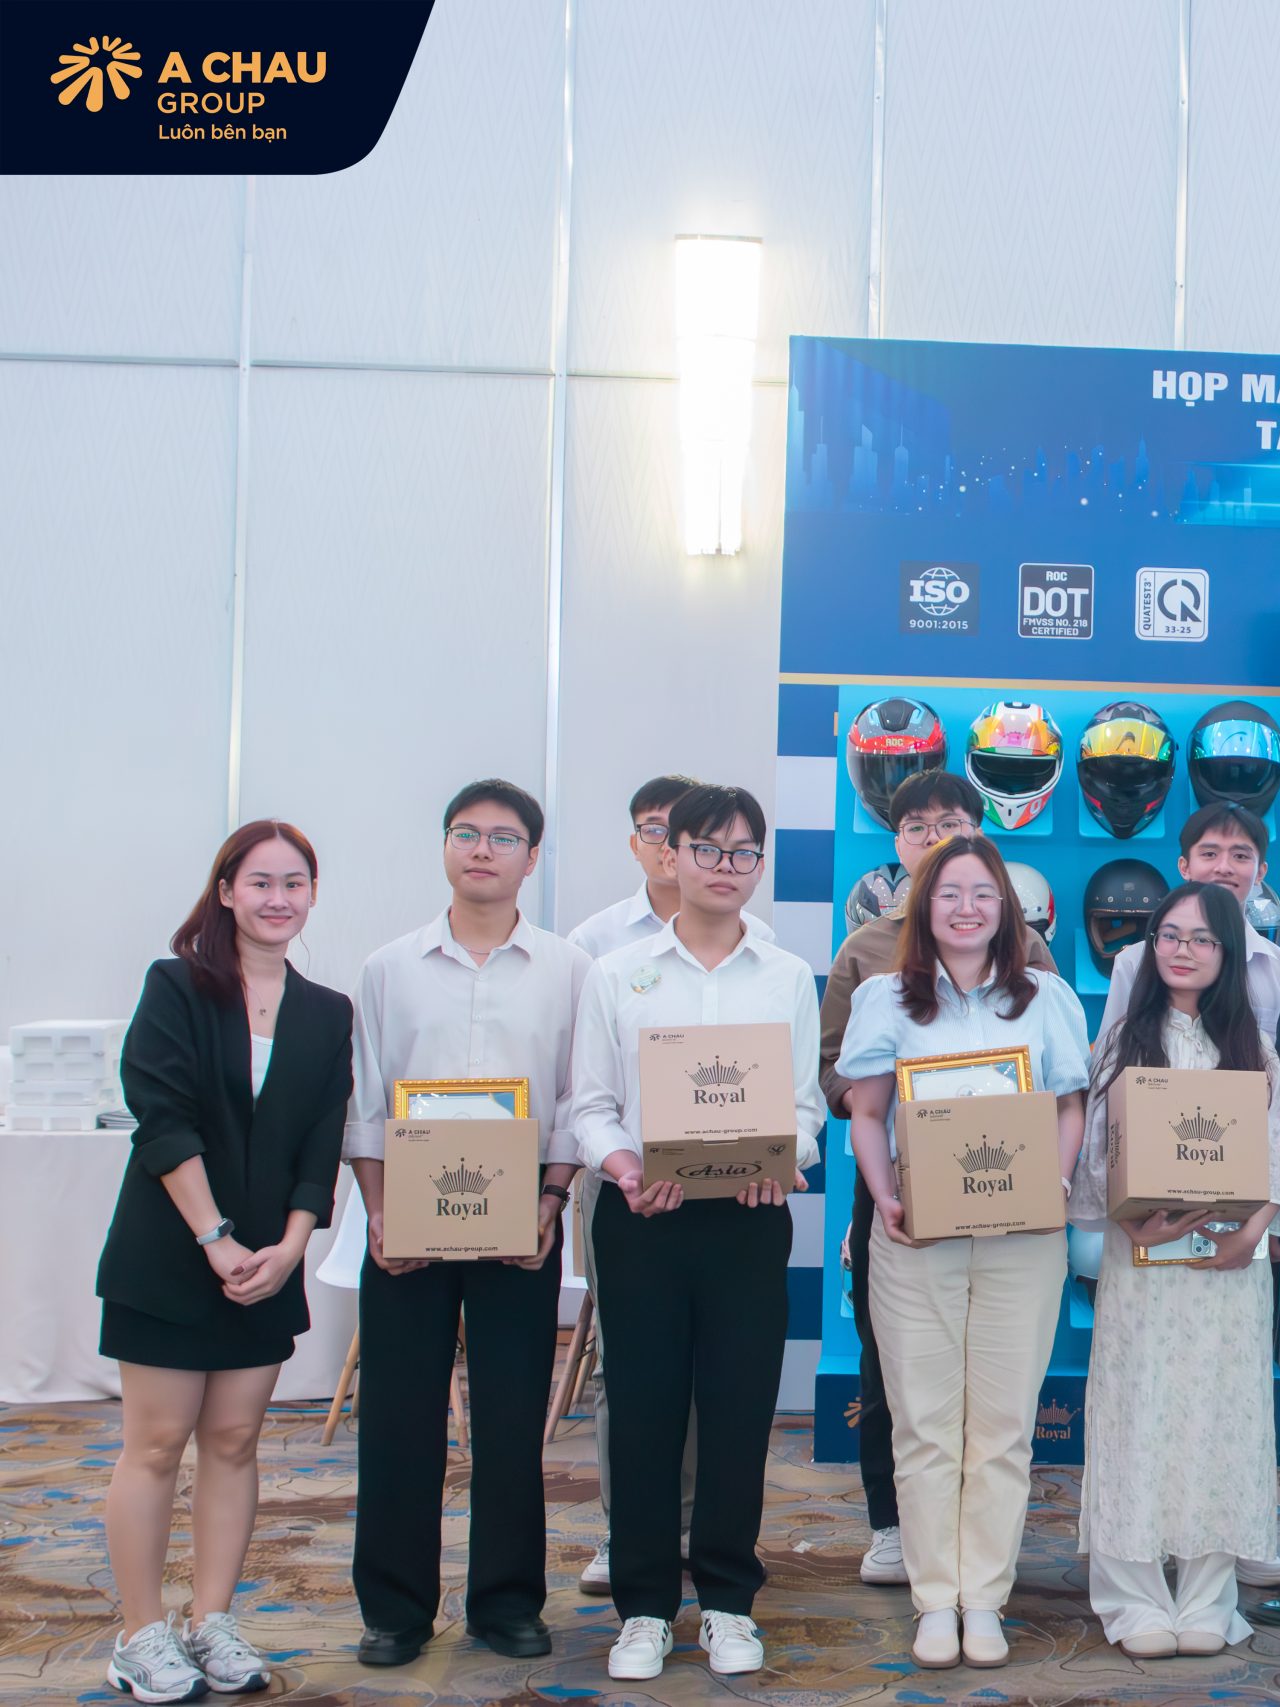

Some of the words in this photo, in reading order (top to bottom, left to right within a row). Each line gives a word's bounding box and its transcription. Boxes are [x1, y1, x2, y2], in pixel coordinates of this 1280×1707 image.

[1152, 370, 1229, 407] HỌP
[1046, 570, 1068, 582] ROC
[909, 579, 970, 604] ISO
[1023, 586, 1089, 618] DOT
[1142, 581, 1152, 631] QUATEST3
[909, 619, 969, 630] 9001:2015
[1023, 617, 1053, 627] FMVSS
[1055, 618, 1071, 628] NO.
[1073, 619, 1088, 628] 218
[1165, 626, 1192, 634] 33-25
[1031, 627, 1079, 637] CERTIFIED
[692, 1087, 746, 1108] Royal
[1175, 1143, 1225, 1166] Royal
[688, 1164, 747, 1177] Asia
[962, 1174, 1014, 1198] Royal
[436, 1198, 489, 1221] Royal
[425, 1245, 499, 1253] www.achau-group.com
[1036, 1426, 1071, 1442] Royal
